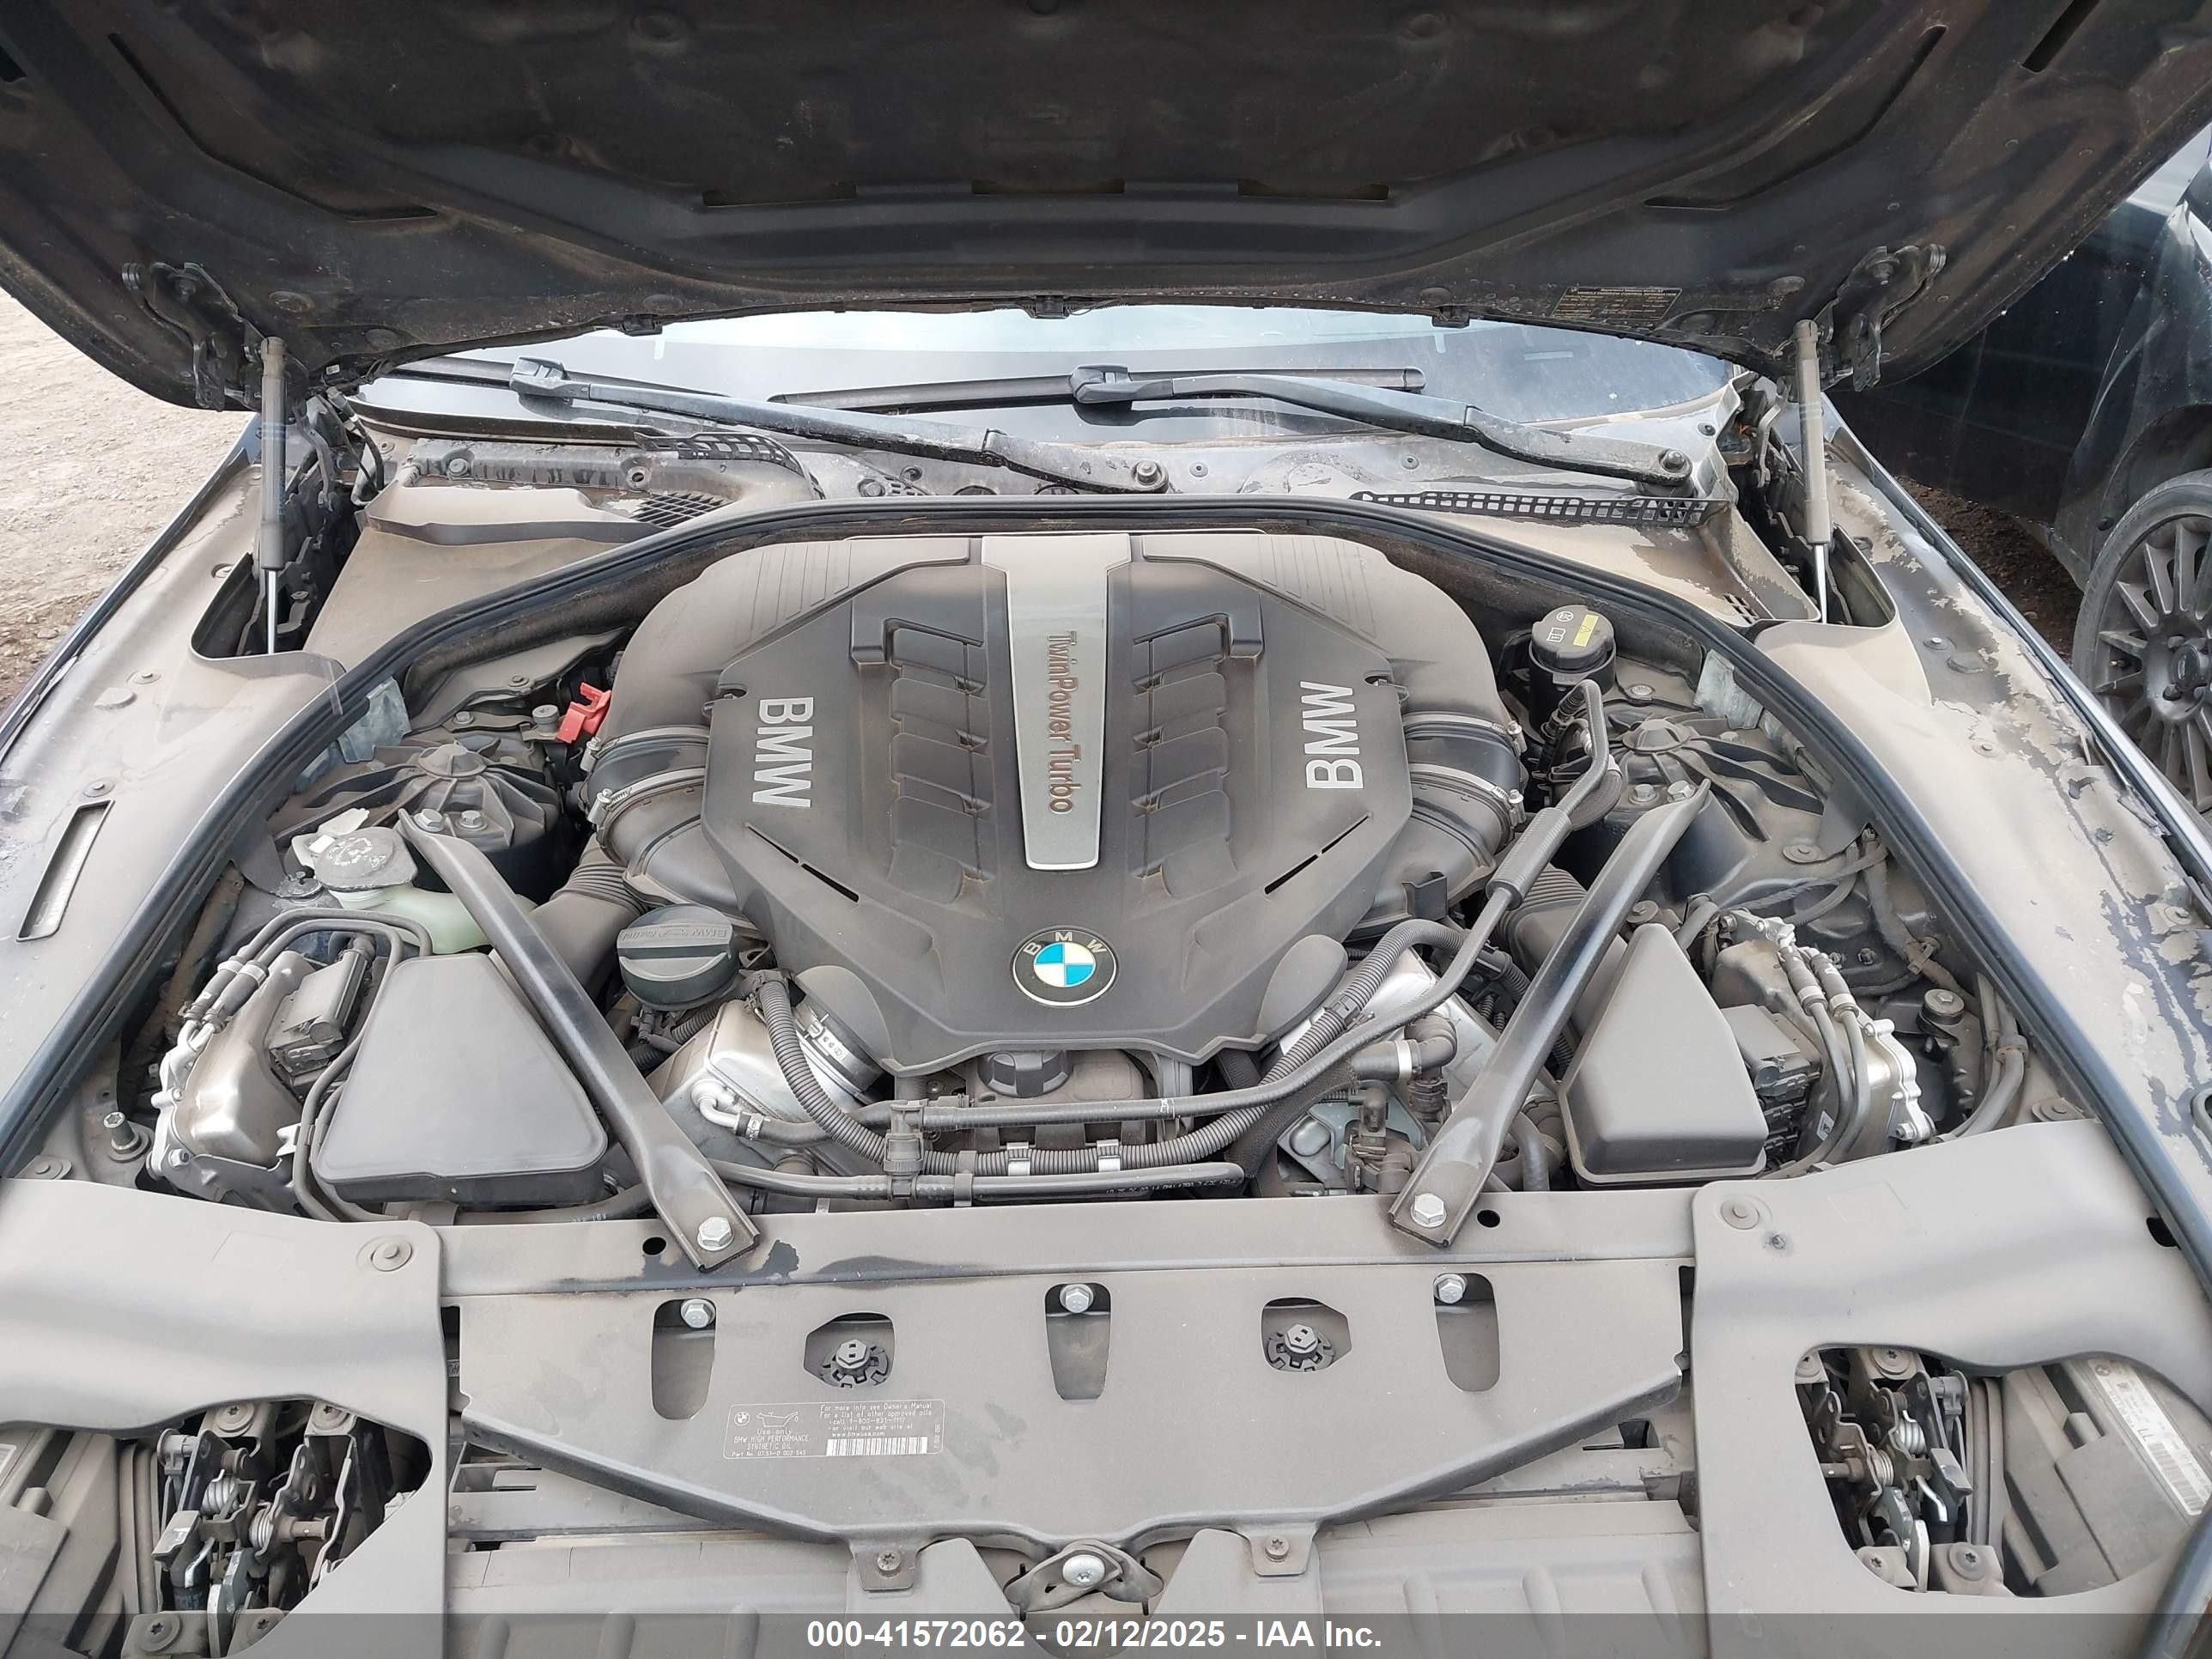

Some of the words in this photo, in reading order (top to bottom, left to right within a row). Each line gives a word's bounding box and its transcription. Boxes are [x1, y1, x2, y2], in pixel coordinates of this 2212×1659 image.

[1047, 631, 1079, 743] TwinPower
[1299, 681, 1364, 789] BMW
[752, 696, 814, 808] BMW
[1048, 744, 1082, 815] Turbo
[1023, 931, 1108, 956] BMW
[867, 1408, 884, 1417] other
[888, 1408, 916, 1419] approved
[919, 1407, 932, 1416] oils
[733, 1435, 748, 1443] BMW
[750, 1435, 765, 1443] HIGH
[767, 1434, 810, 1443] PERFORMANCE
[775, 1428, 792, 1437] only
[747, 1442, 780, 1450] SYNTHETIC
